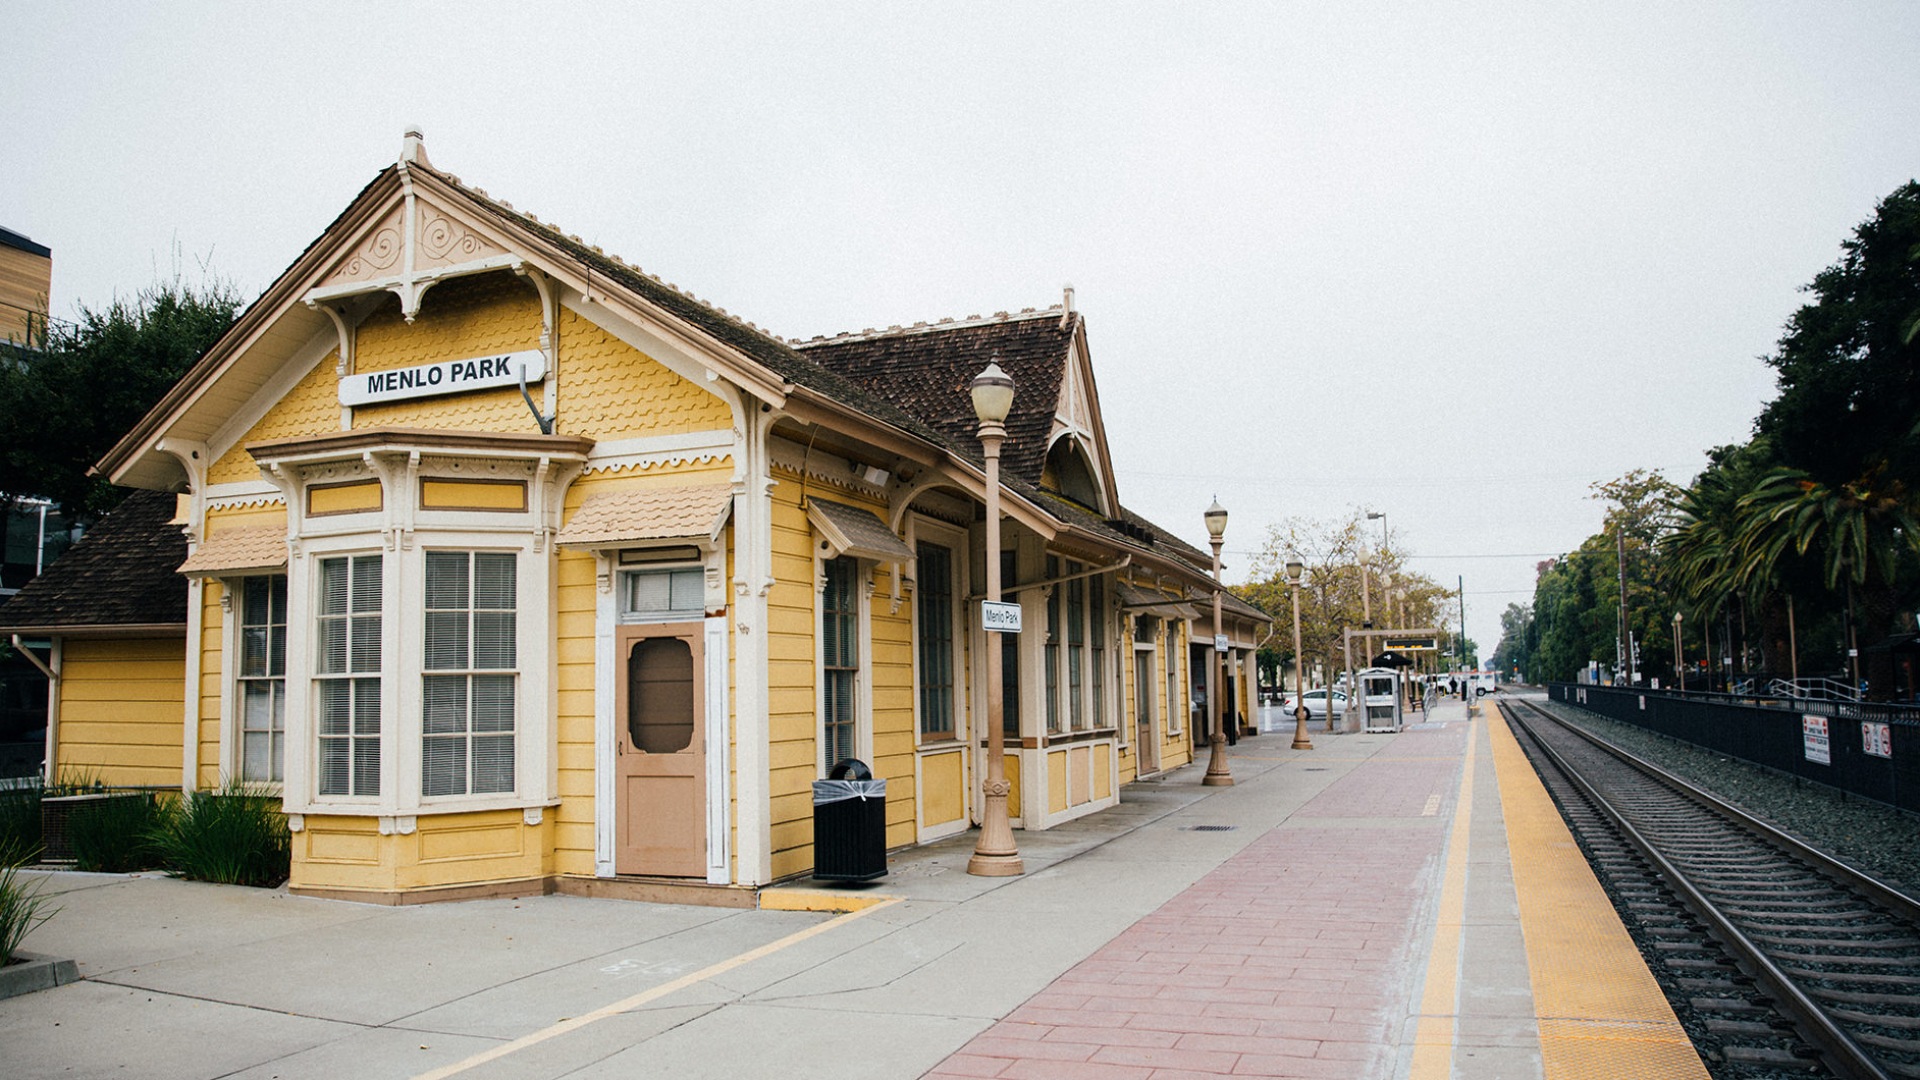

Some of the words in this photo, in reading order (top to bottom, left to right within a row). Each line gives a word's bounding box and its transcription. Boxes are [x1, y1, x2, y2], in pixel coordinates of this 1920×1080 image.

[368, 366, 442, 394] MENLO
[451, 356, 511, 382] PARK
[986, 609, 1004, 623] Menlo
[1005, 610, 1018, 624] Park
